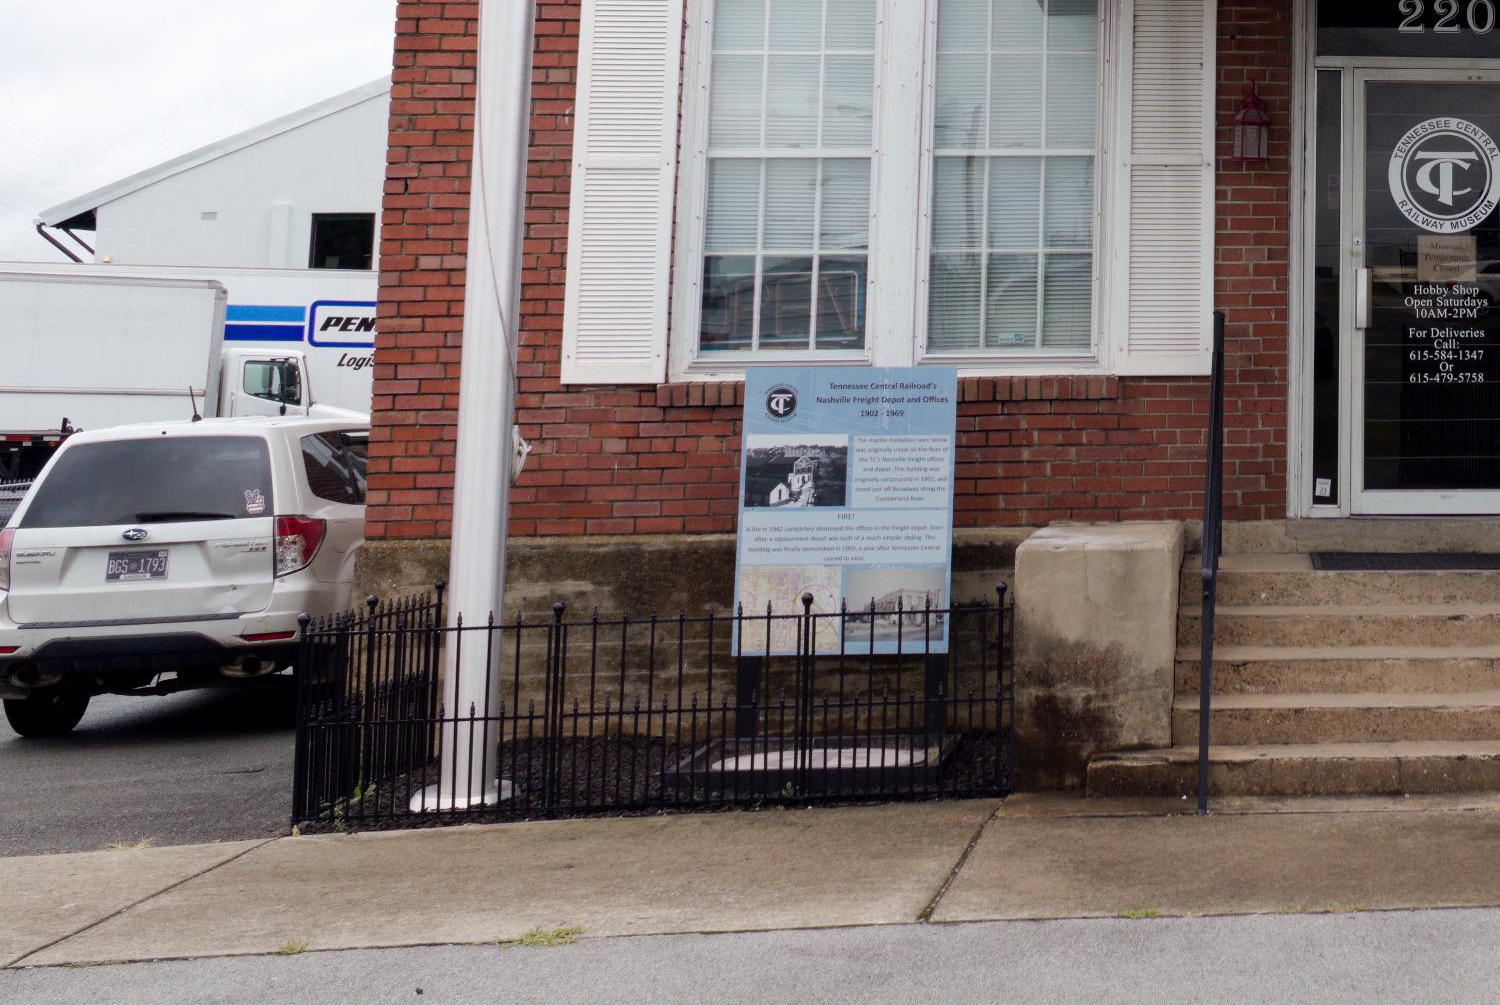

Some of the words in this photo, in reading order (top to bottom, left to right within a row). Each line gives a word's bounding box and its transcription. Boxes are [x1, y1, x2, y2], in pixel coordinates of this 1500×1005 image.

[1394, 119, 1451, 159] TENNESSEE
[1456, 121, 1499, 161] CENTRAL
[1398, 199, 1445, 230] RAILWAY
[1450, 199, 1495, 230] MUSEUM
[1414, 284, 1449, 296] Hobby
[1452, 285, 1479, 296] Shop
[1404, 297, 1432, 308] Open
[1436, 297, 1488, 308] Saturdays
[1416, 308, 1477, 318] 10AM-2PM
[1409, 328, 1428, 338] For
[1431, 328, 1485, 338] Deliveries
[1434, 339, 1460, 349] Call:
[1410, 350, 1484, 360] 615-584-1347
[1440, 362, 1454, 372] Or
[1410, 373, 1484, 383] 615-479-5758
[108, 560, 128, 574] BGS
[138, 558, 166, 572] 1793
